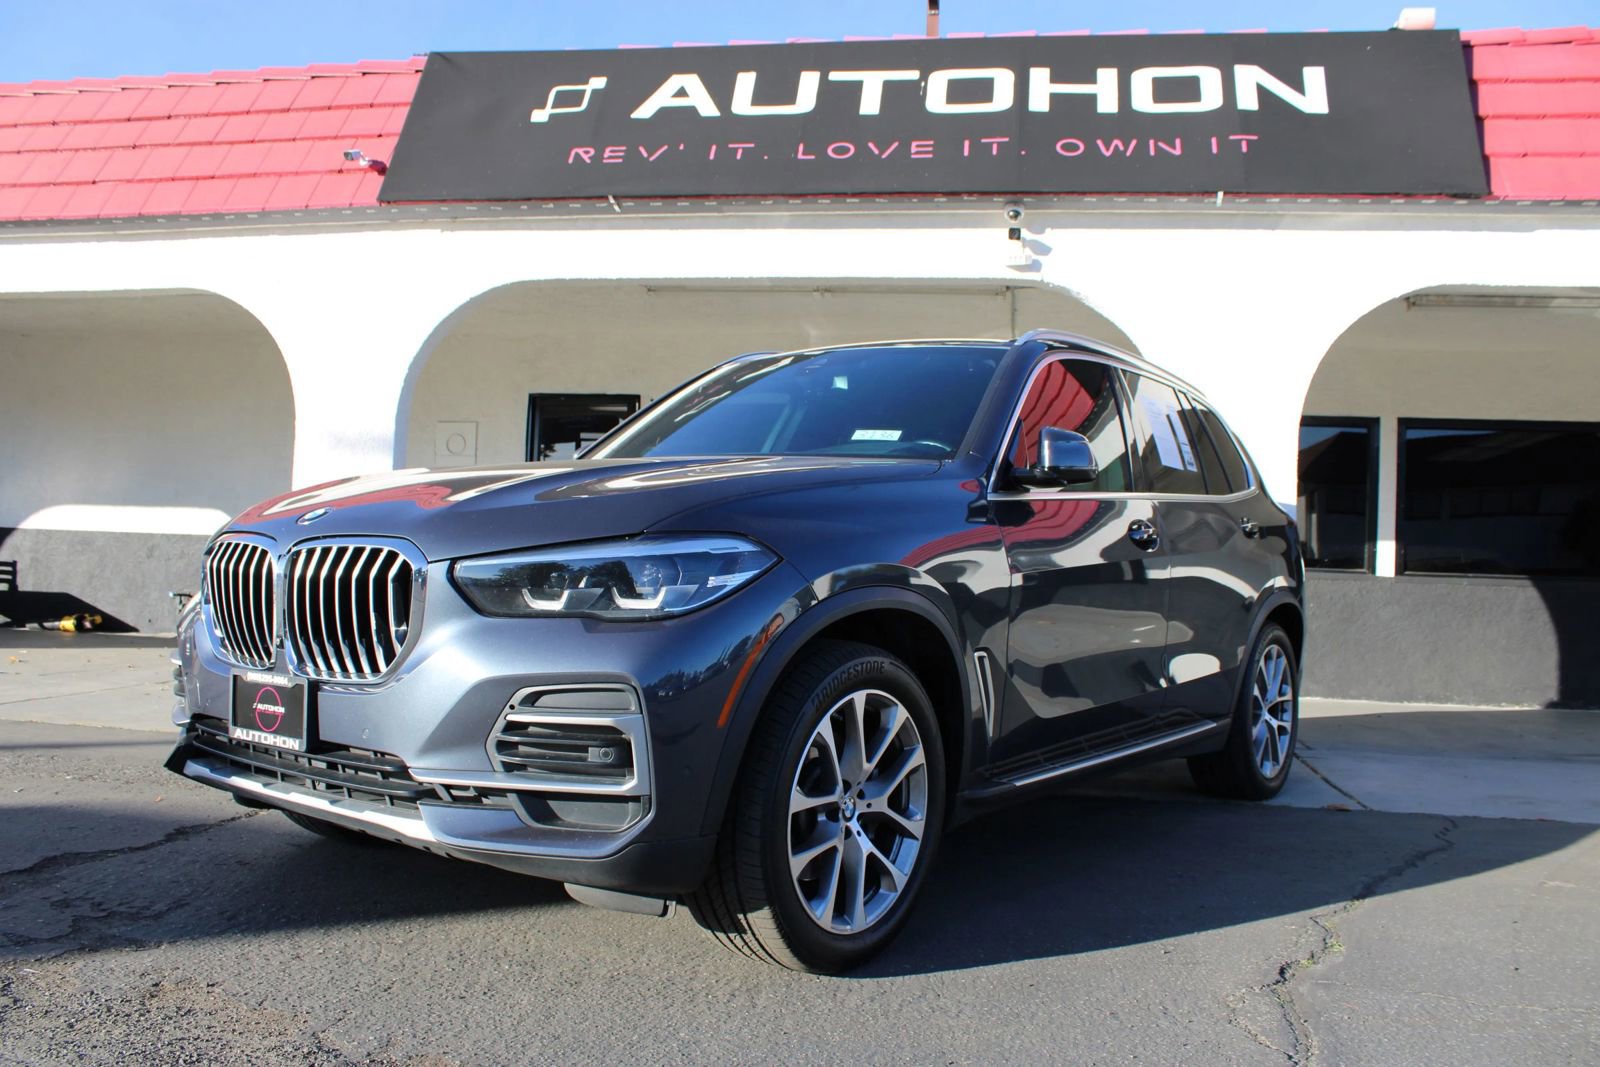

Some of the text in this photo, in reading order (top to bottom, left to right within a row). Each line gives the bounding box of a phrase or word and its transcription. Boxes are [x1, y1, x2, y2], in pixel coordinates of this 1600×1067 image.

[630, 64, 1330, 118] AUTOHON
[797, 138, 934, 160] LOVE
[1055, 136, 1183, 157] OWN
[1210, 134, 1259, 154] IT
[233, 728, 300, 750] AUTOHON
